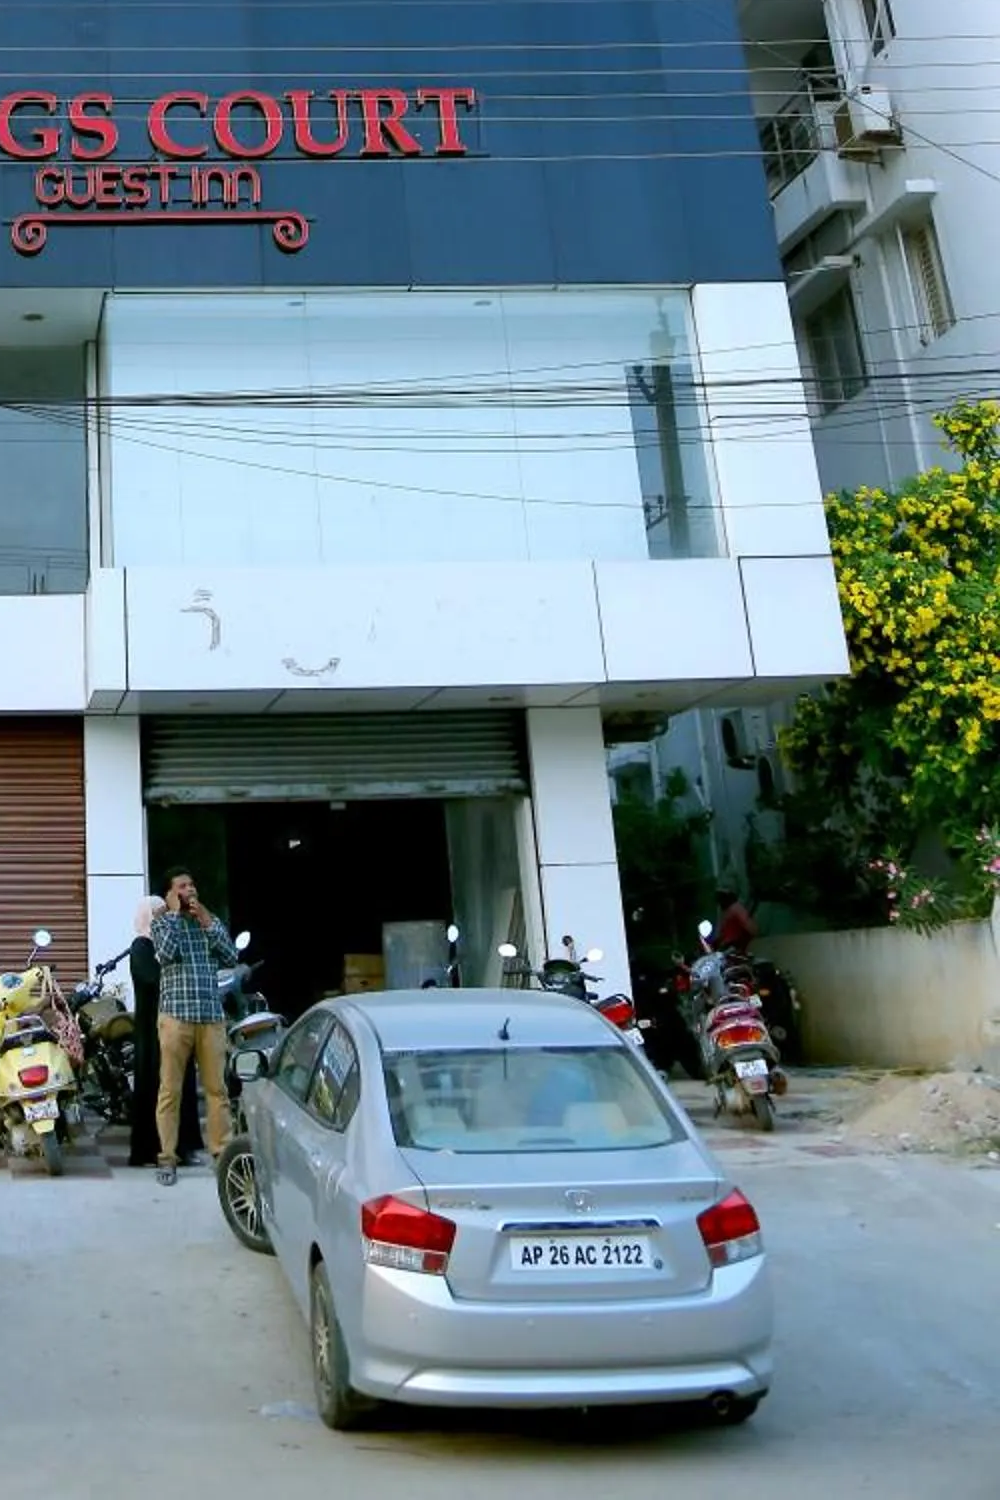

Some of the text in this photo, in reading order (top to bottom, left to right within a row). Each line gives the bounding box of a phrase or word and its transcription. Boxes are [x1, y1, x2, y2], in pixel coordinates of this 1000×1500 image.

[147, 88, 478, 160] COURT
[34, 165, 180, 208] GUEST
[520, 1244, 643, 1266] AP 26 AC 2122
